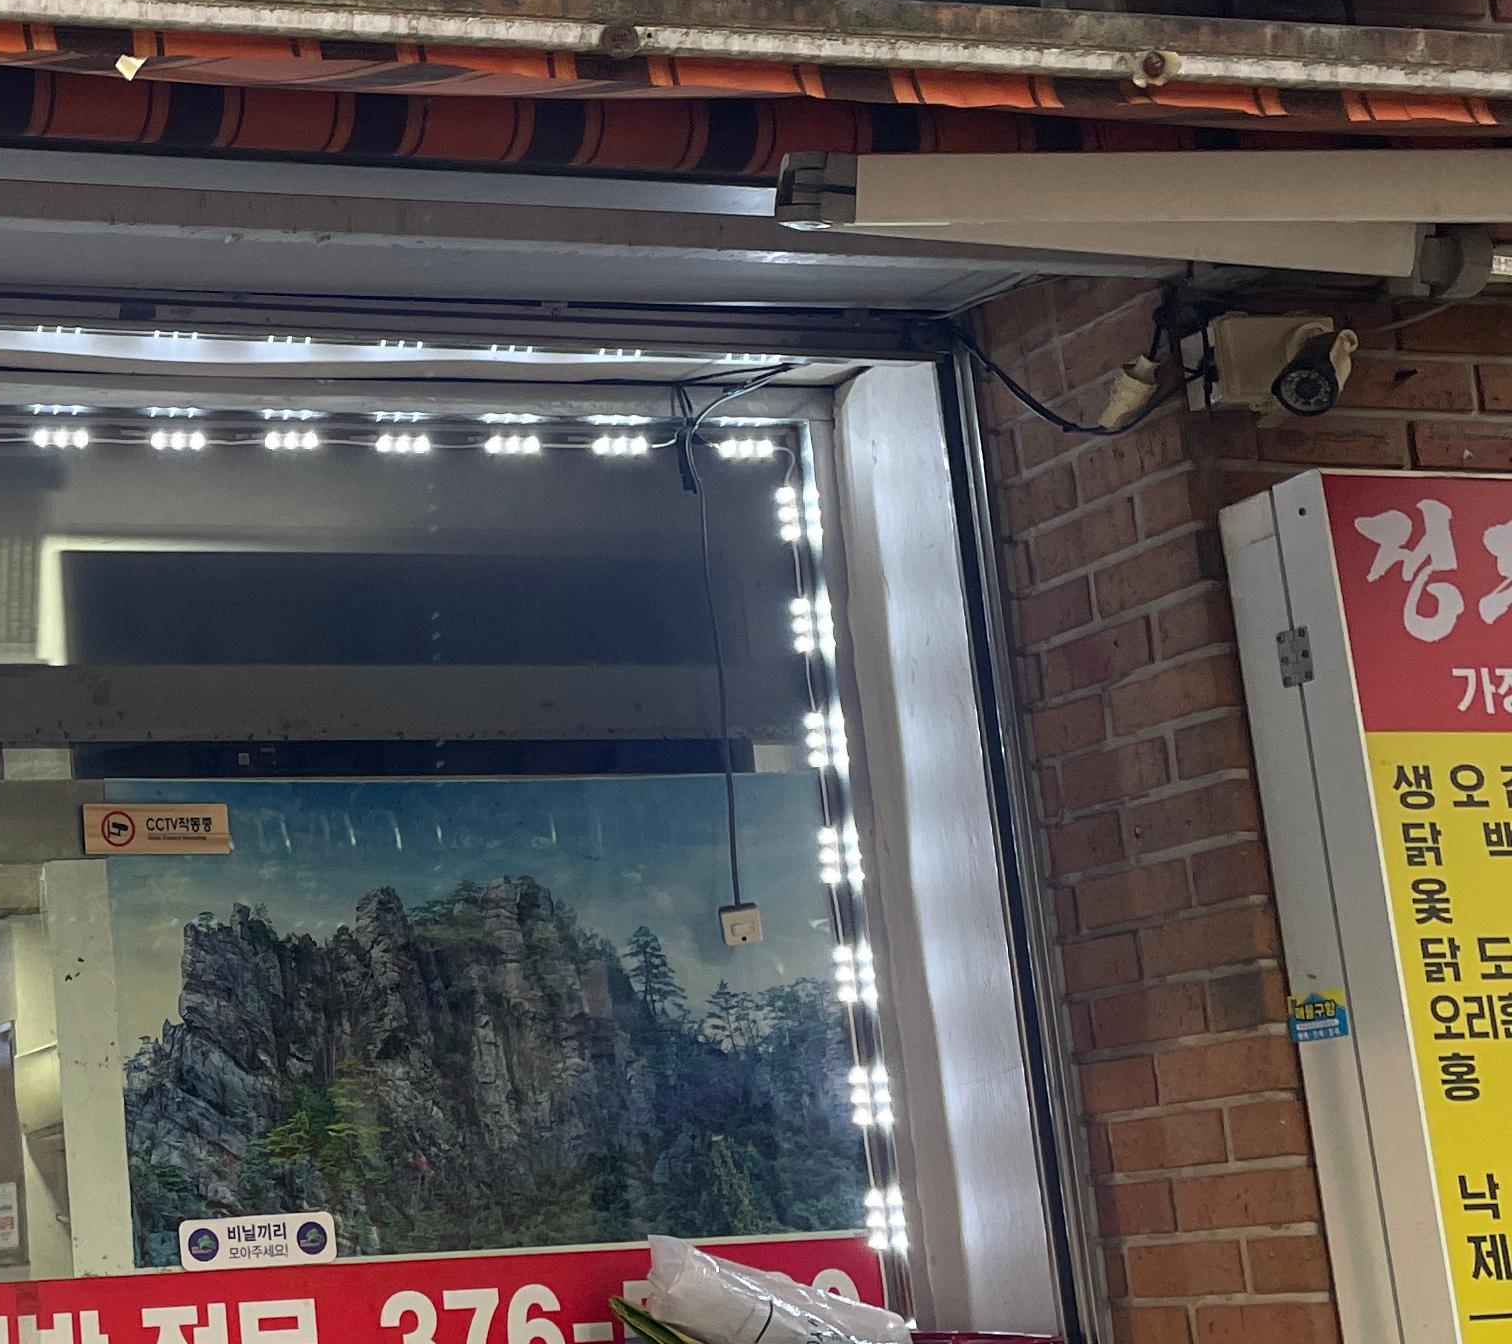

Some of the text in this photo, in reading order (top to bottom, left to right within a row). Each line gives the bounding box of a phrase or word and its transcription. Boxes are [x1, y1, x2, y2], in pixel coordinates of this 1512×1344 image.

[145, 817, 213, 833] CCTV작동중
[1438, 1052, 1480, 1102] 홍
[1458, 1173, 1501, 1220] 낙
[227, 1222, 287, 1243] 비닐끼리
[228, 1244, 289, 1259] 모아주세요!
